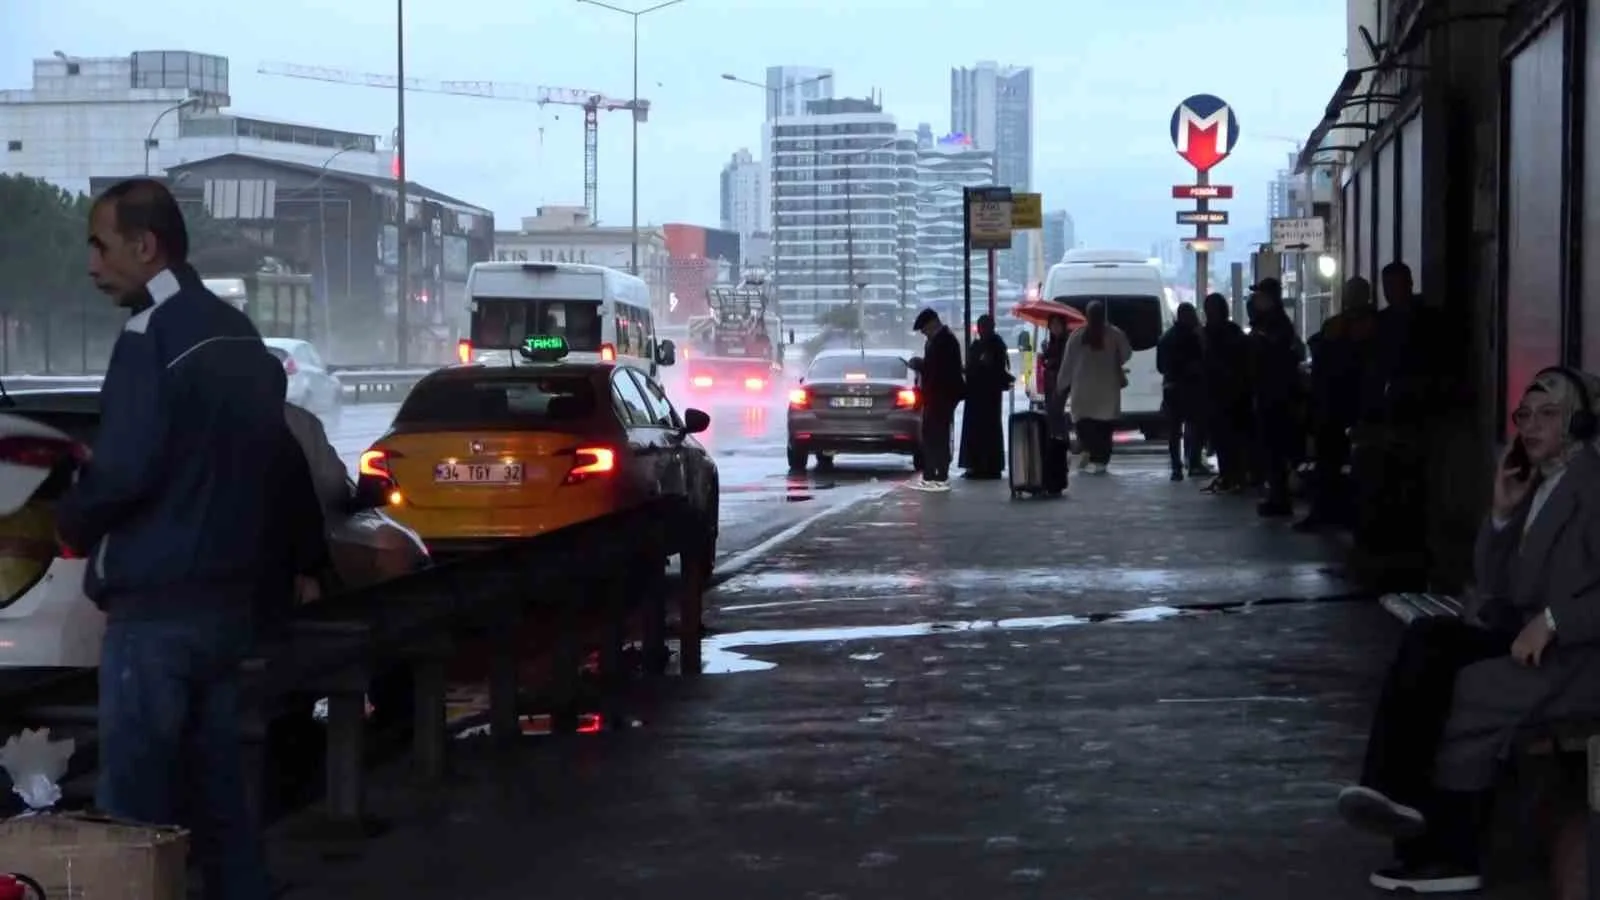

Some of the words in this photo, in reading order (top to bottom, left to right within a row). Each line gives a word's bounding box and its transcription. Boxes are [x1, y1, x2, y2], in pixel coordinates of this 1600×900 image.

[444, 465, 459, 480] 34
[468, 465, 491, 480] TGY
[503, 465, 520, 480] 32
